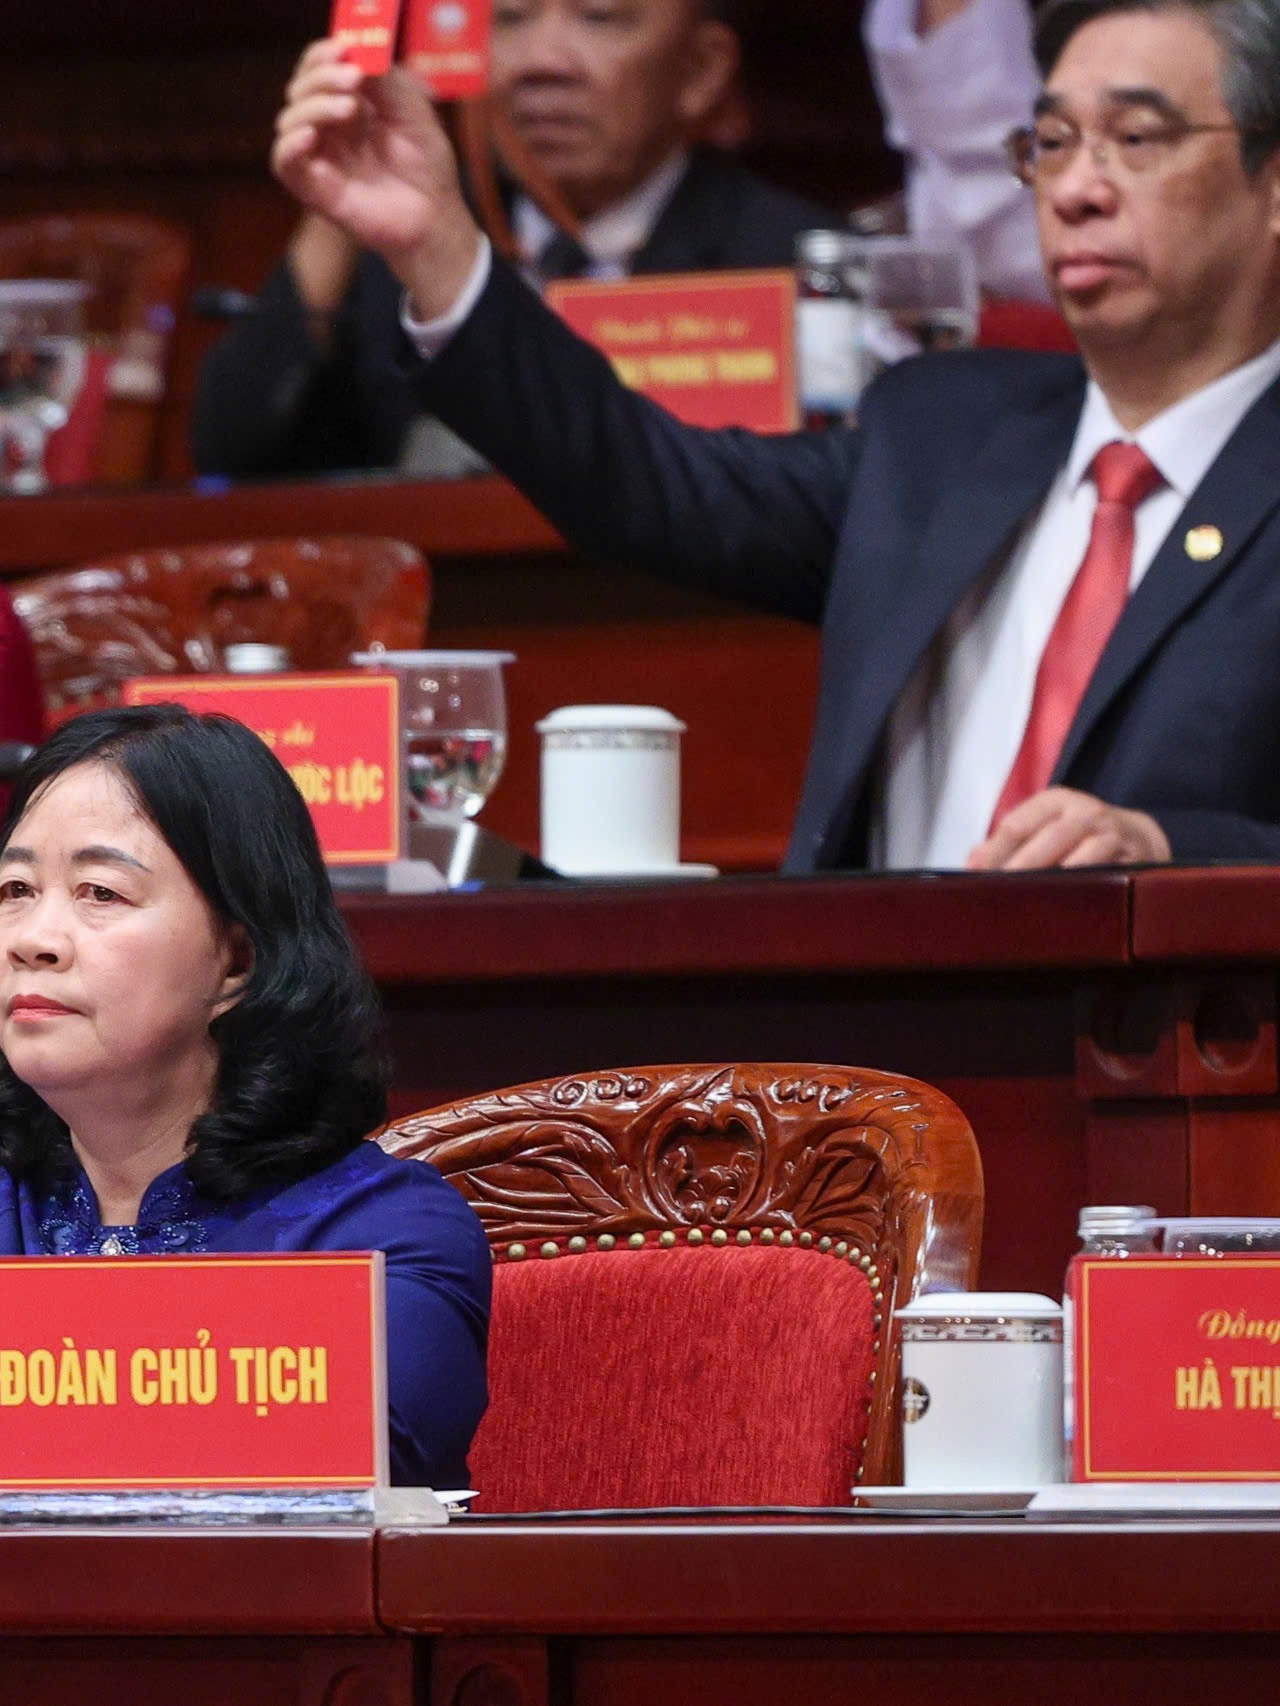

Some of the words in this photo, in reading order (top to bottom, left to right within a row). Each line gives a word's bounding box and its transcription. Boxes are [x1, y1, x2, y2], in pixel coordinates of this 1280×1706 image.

[130, 1328, 218, 1405] CHỦ
[229, 1346, 329, 1417] TỊCH
[1175, 1357, 1222, 1409] HÀ
